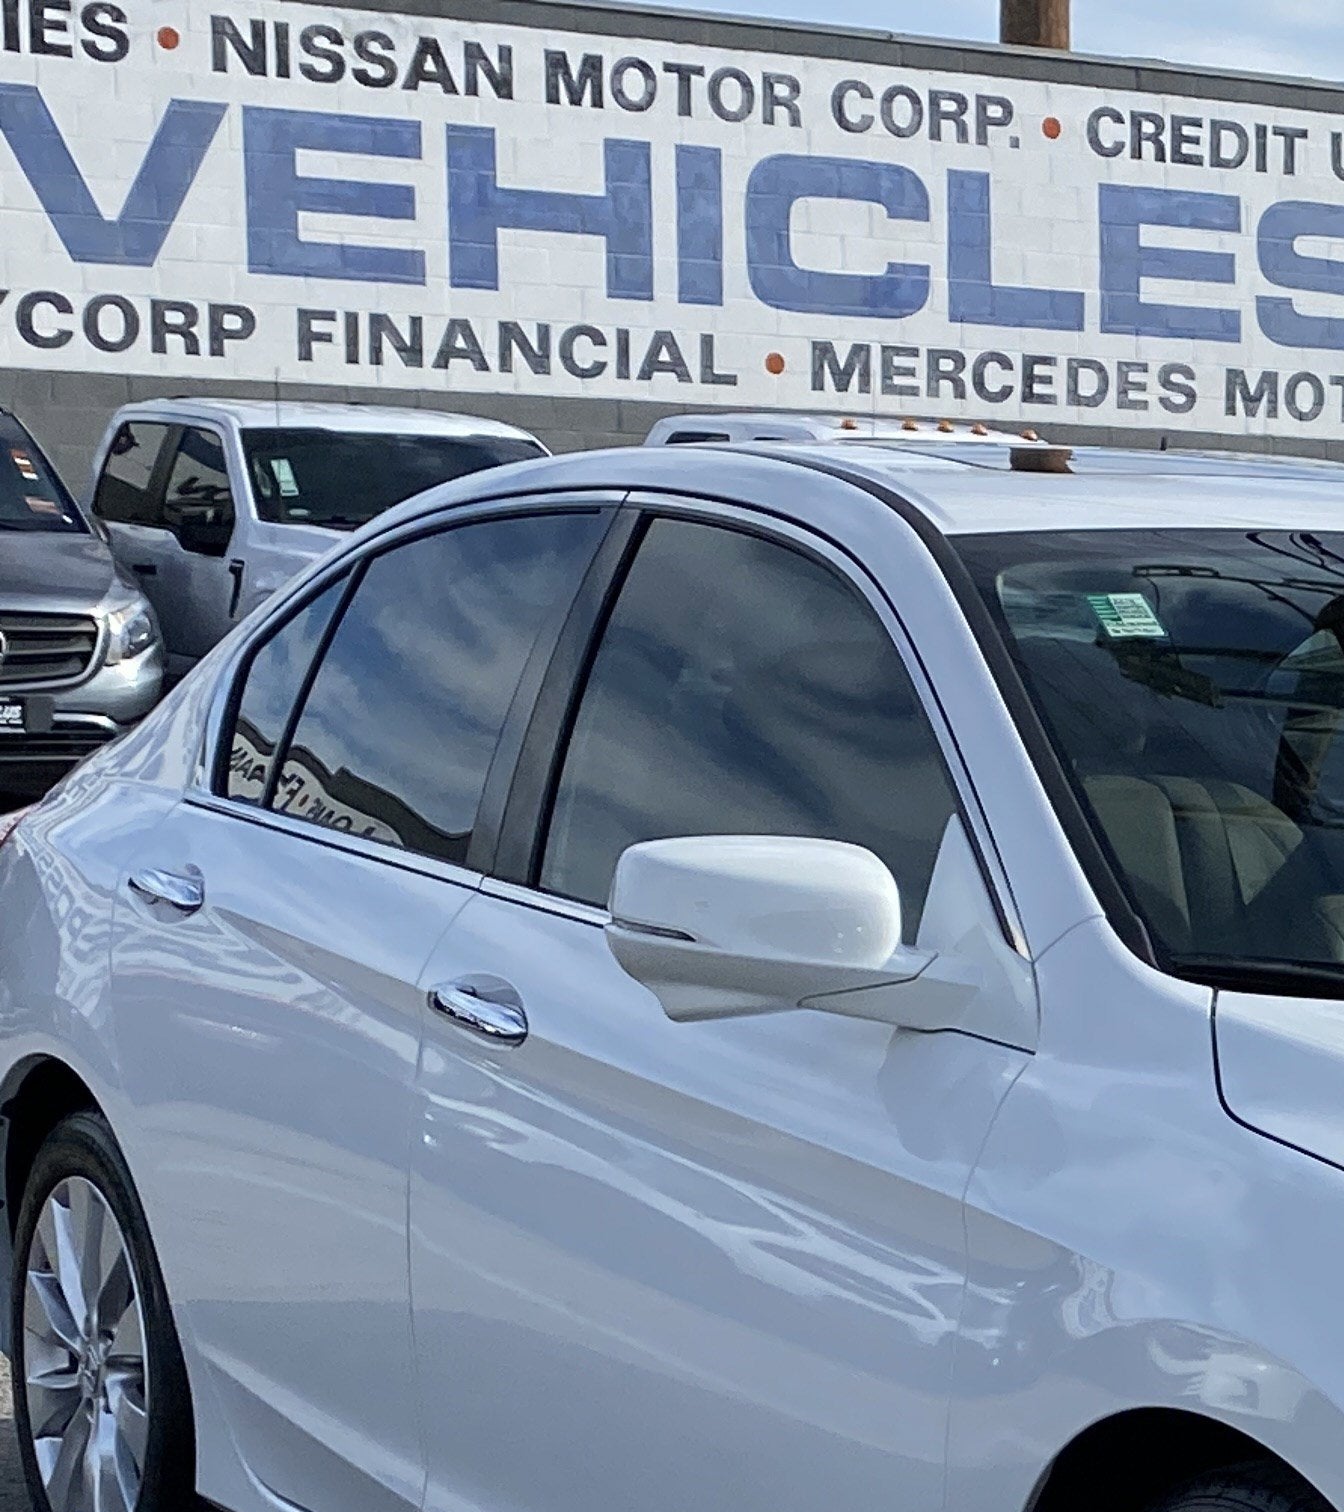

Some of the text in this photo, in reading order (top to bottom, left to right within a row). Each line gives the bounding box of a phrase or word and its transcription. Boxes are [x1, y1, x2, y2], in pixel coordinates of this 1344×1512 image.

[210, 14, 515, 101] NISSAN
[544, 49, 802, 129] MOTOR
[831, 78, 1021, 149] CORP.
[1086, 106, 1309, 176] CREDIT
[0, 289, 257, 357] CORP
[297, 307, 738, 387] FINANCIAL
[810, 339, 1197, 414] MERCEDES
